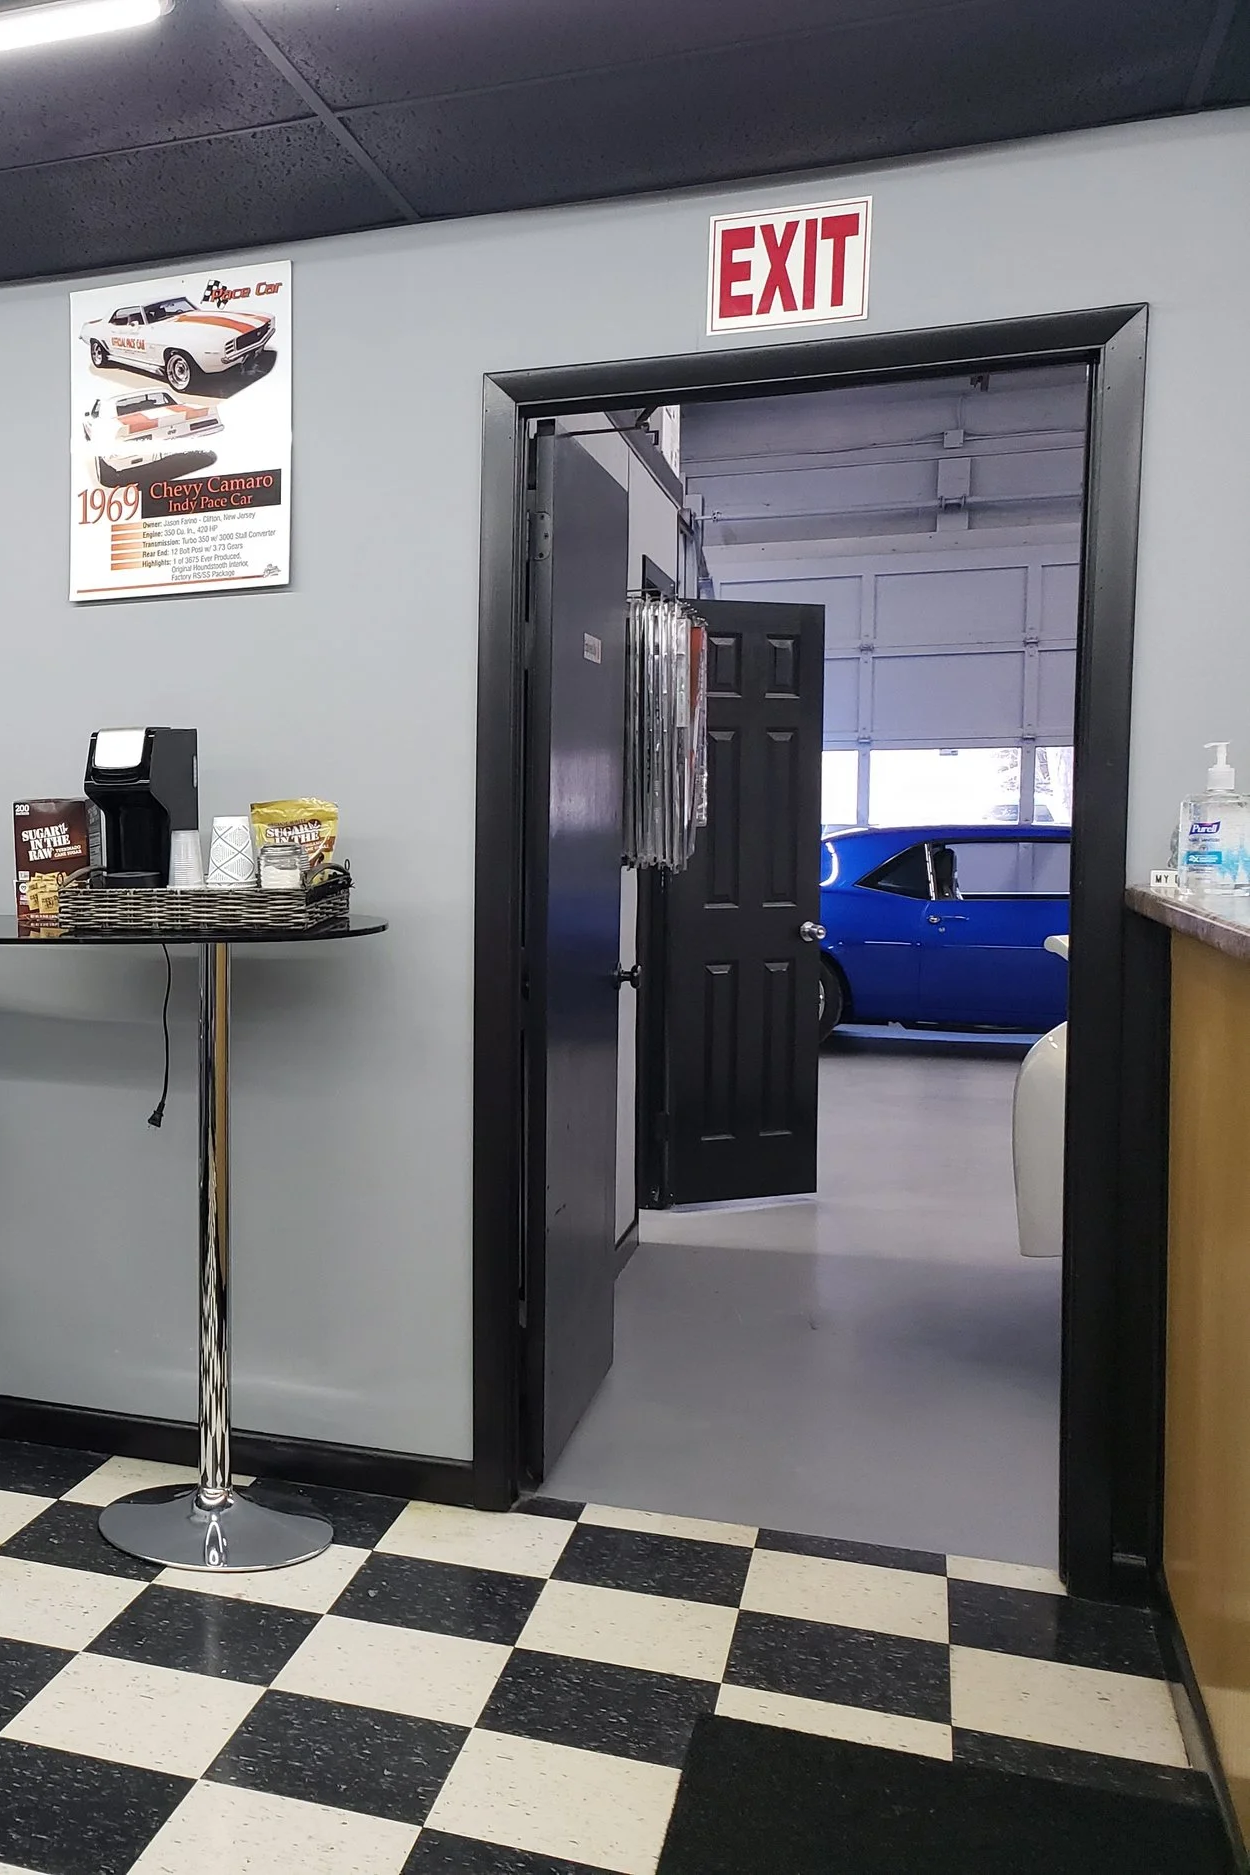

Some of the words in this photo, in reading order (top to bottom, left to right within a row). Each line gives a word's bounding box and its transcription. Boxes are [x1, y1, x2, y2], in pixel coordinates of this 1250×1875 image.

[719, 213, 860, 319] EXIT
[210, 286, 251, 303] Pace
[254, 281, 283, 296] Car
[150, 480, 204, 500] Chevy
[207, 474, 274, 494] Camaro
[77, 482, 139, 525] 1969
[168, 498, 197, 514] Indy
[200, 496, 229, 509] Pace
[230, 493, 253, 506] Car
[142, 521, 162, 529] Owner:
[163, 519, 180, 527] Jason
[223, 513, 237, 521] New
[237, 511, 256, 520] Jersey
[142, 531, 163, 539] Engine:
[164, 529, 176, 537] 350
[197, 525, 209, 534] 420
[209, 524, 218, 532] HP
[142, 539, 180, 549] Transmission:
[182, 537, 198, 546] Turbo
[198, 535, 210, 543] 350
[218, 532, 234, 541] 3000
[235, 531, 247, 540] Stall
[248, 529, 276, 539] Converter
[142, 550, 156, 559] Rear
[157, 548, 170, 557] End:
[171, 547, 179, 556] 12
[179, 547, 190, 555] Bolt
[212, 543, 226, 552] 3.73
[226, 542, 244, 551] Gears
[142, 559, 172, 569] Highlights:
[177, 557, 184, 565] of
[200, 554, 213, 563] Ever
[171, 564, 192, 574] Original
[192, 562, 228, 571] Houndstooth
[171, 573, 191, 582] Factory
[192, 571, 211, 580] RS/SS
[211, 569, 235, 578] Package
[15, 804, 30, 812] 200
[21, 825, 63, 842] SUGAR
[266, 822, 310, 838] SUGAR
[291, 830, 320, 845] THE
[30, 839, 44, 851] IN
[44, 833, 71, 849] THE
[28, 848, 54, 862] RAW
[1155, 874, 1169, 884] MY
